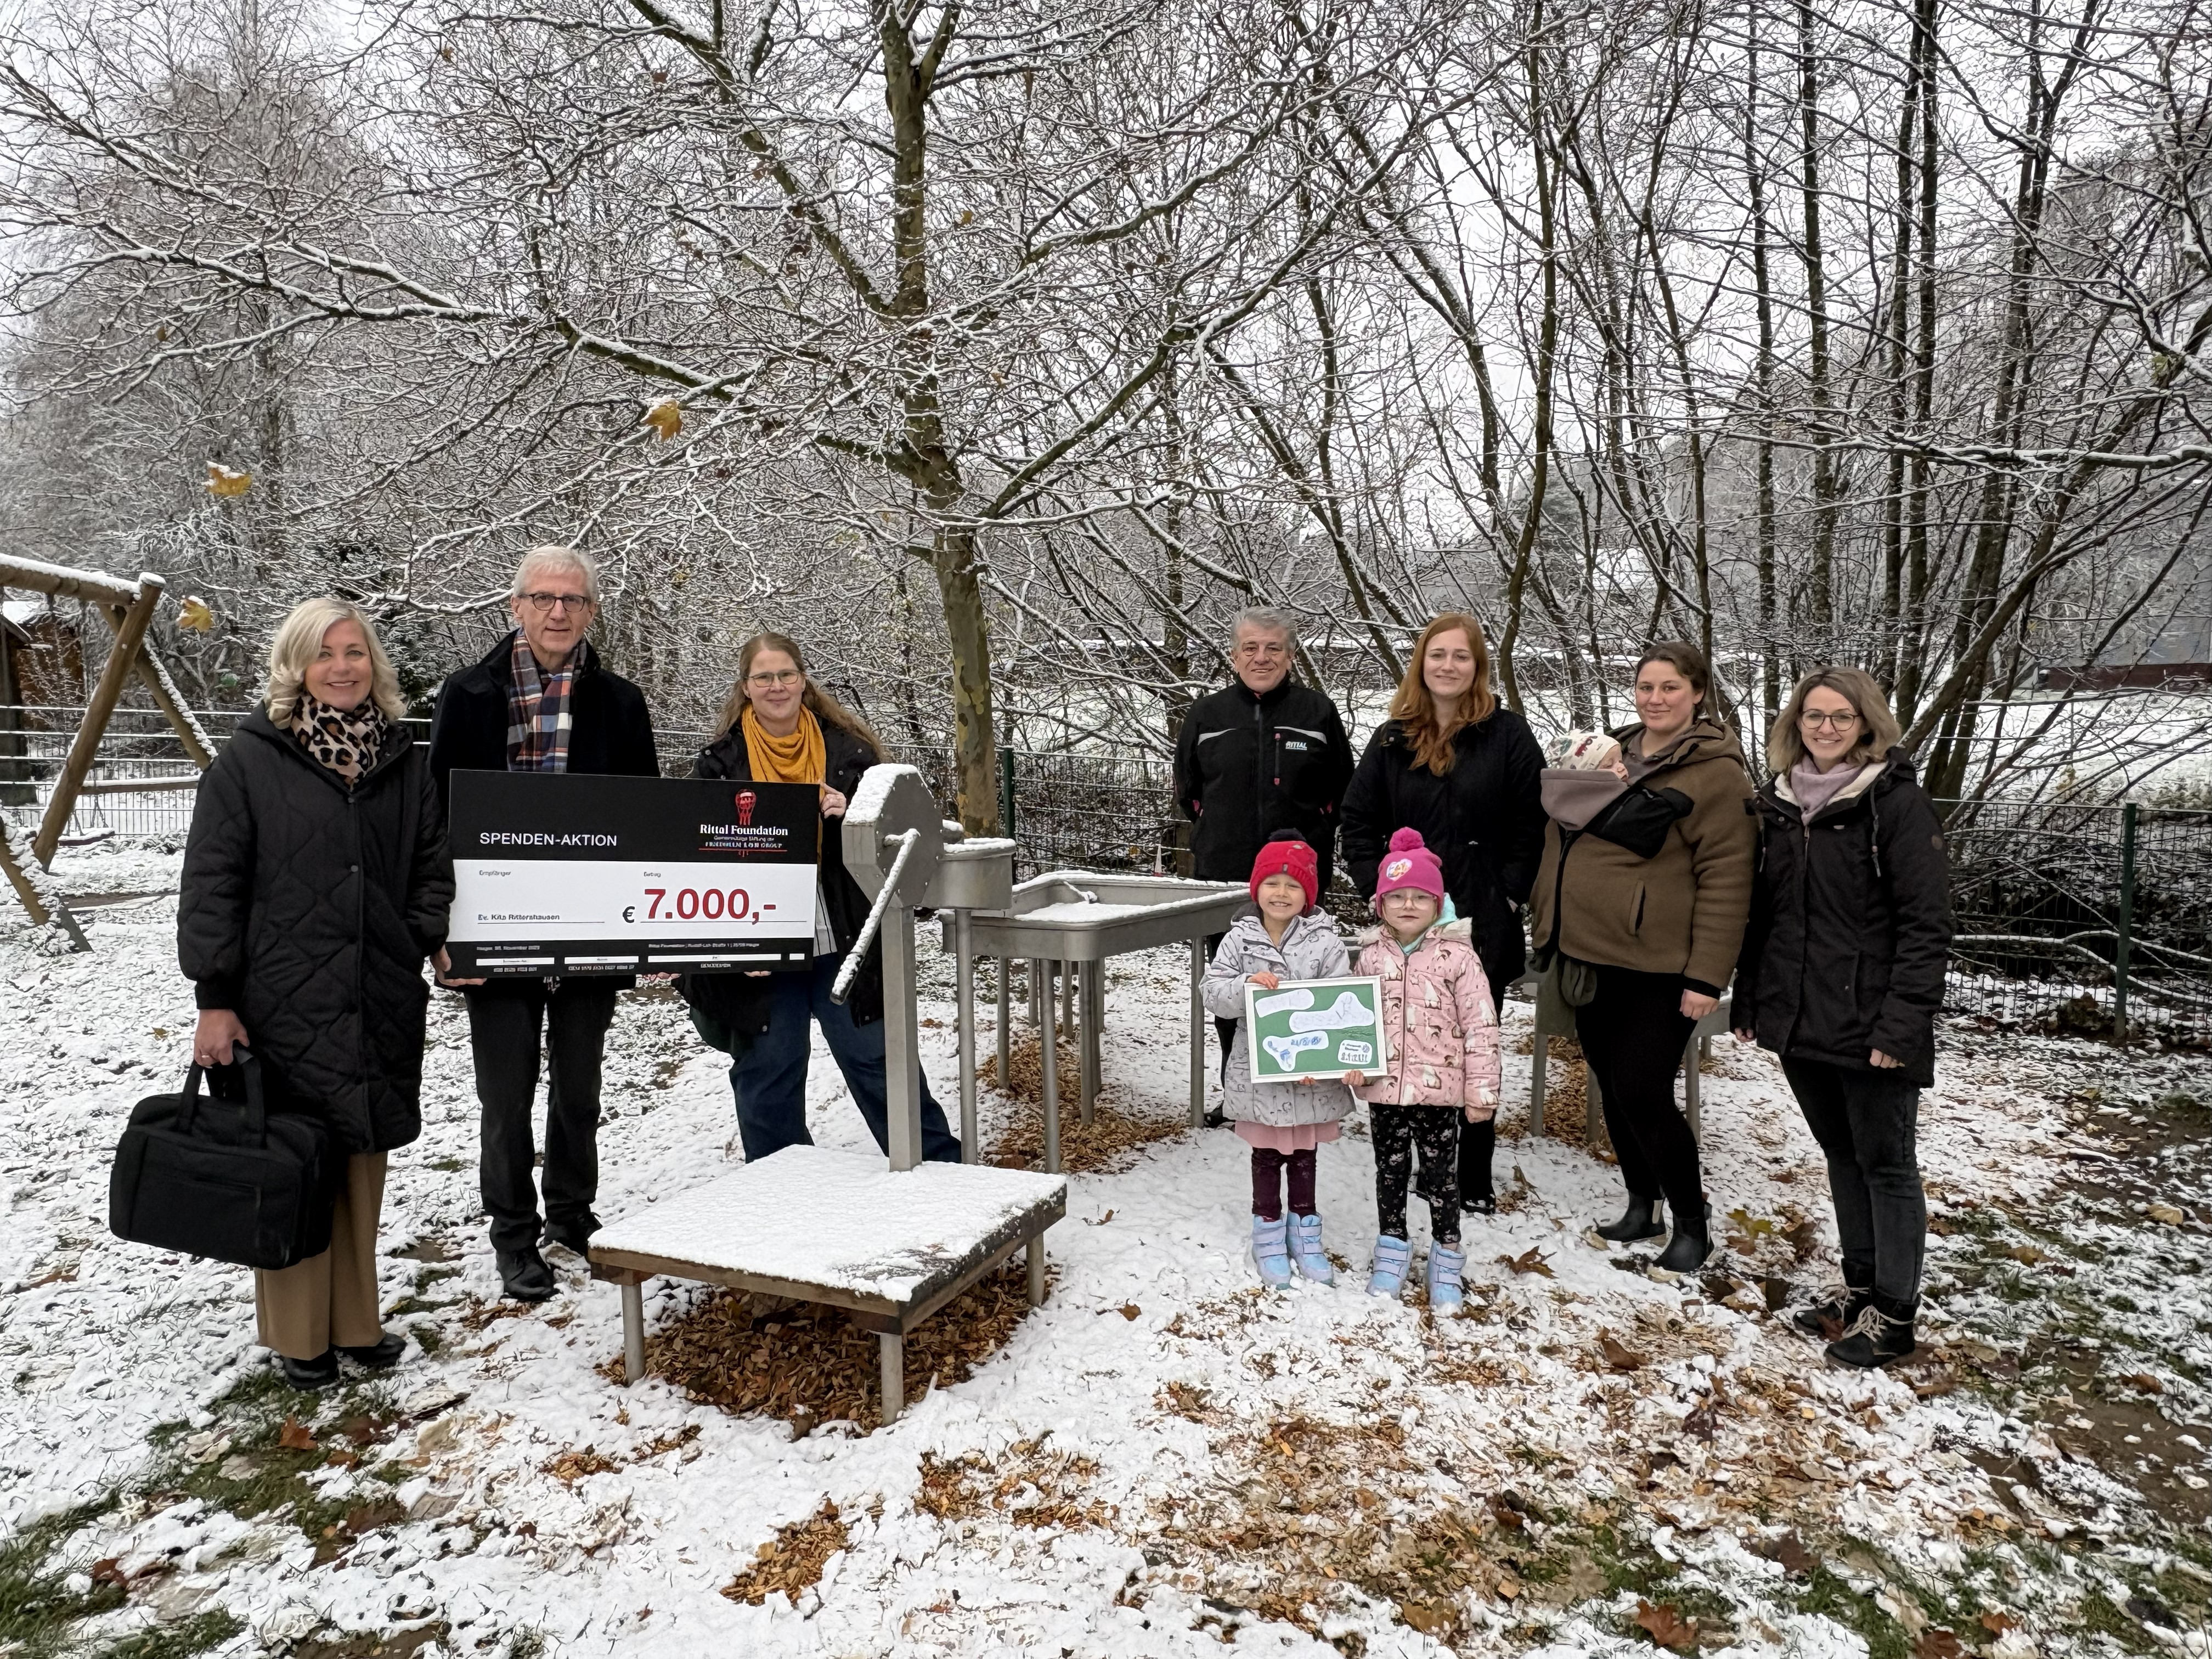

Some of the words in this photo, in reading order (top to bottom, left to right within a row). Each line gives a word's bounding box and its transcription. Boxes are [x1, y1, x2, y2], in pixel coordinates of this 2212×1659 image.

[700, 824, 729, 834] Rittal
[731, 825, 788, 836] Foundation
[479, 832, 617, 847] SPENDEN-AKTION
[622, 906, 635, 923] €
[644, 888, 776, 926] 7.000,-
